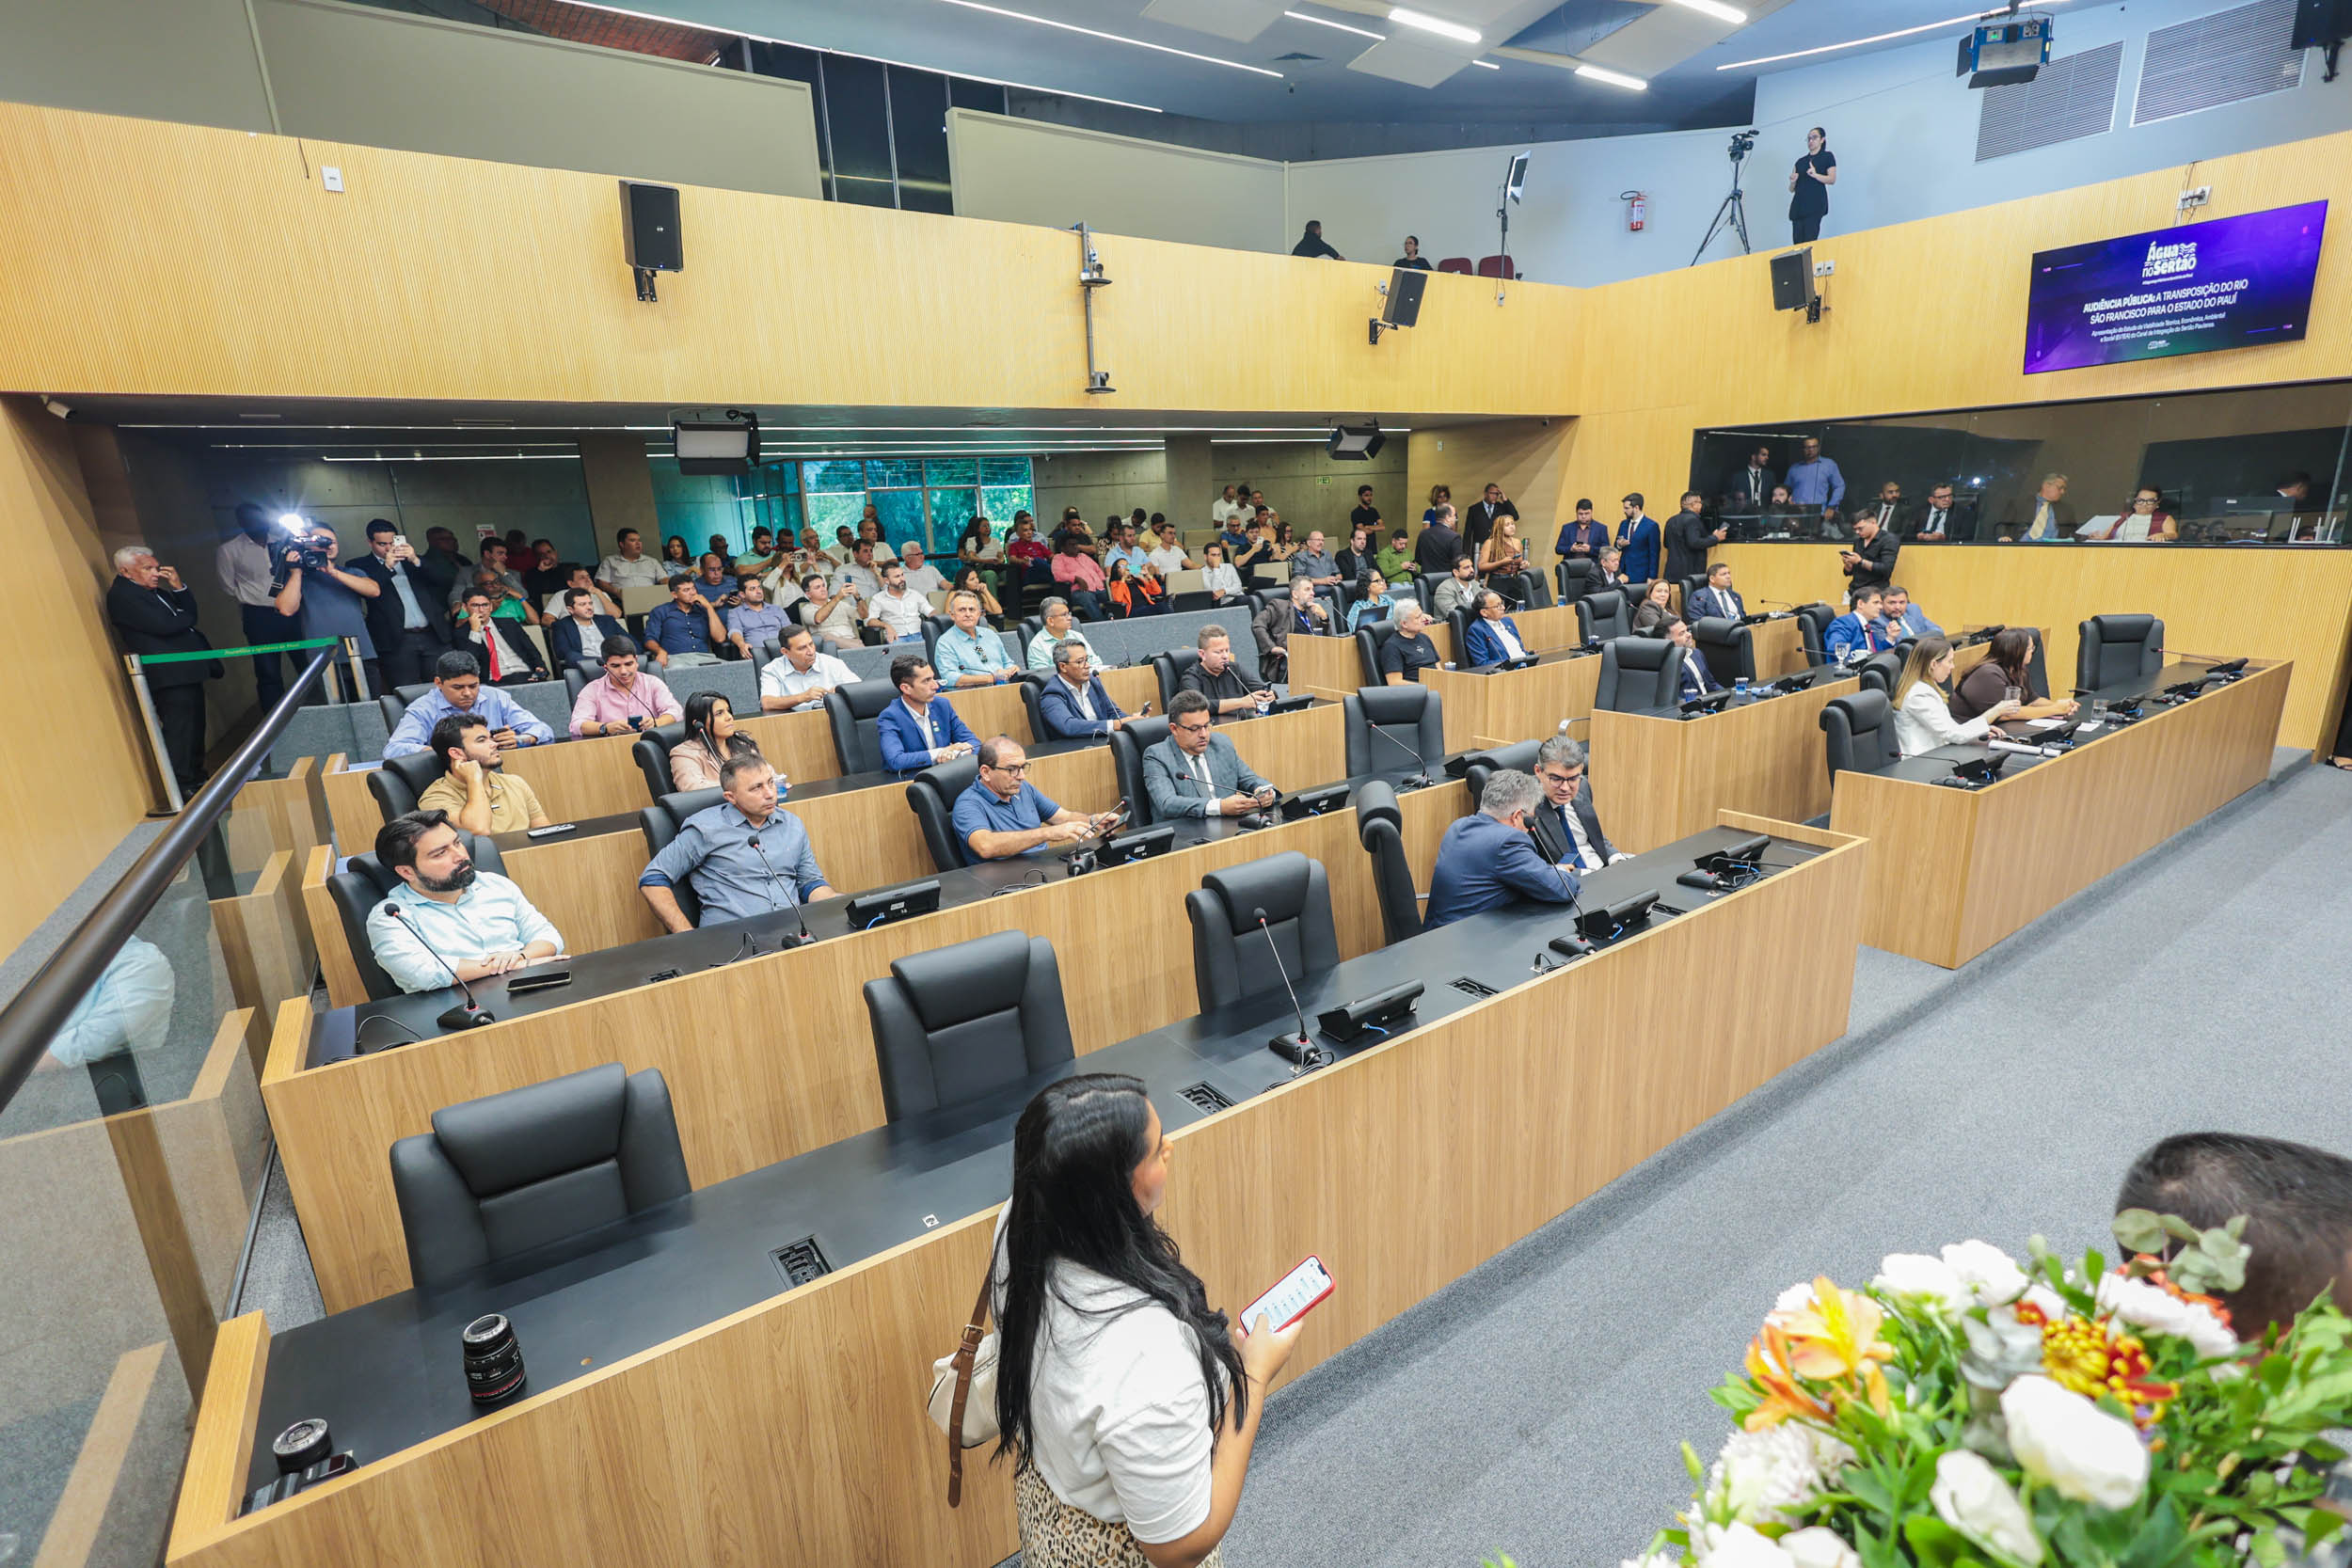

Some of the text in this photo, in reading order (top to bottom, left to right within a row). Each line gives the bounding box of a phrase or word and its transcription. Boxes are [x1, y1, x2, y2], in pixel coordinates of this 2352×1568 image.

[2142, 267, 2153, 277] no
[2082, 278, 2249, 313] AUDIÊNCIA PÚBLICA: A TRANSPOSIÇÃO DO RIO
[2090, 291, 2238, 325] SÃO FRANCISCO PARA O ESTADO DO PIAUÍ
